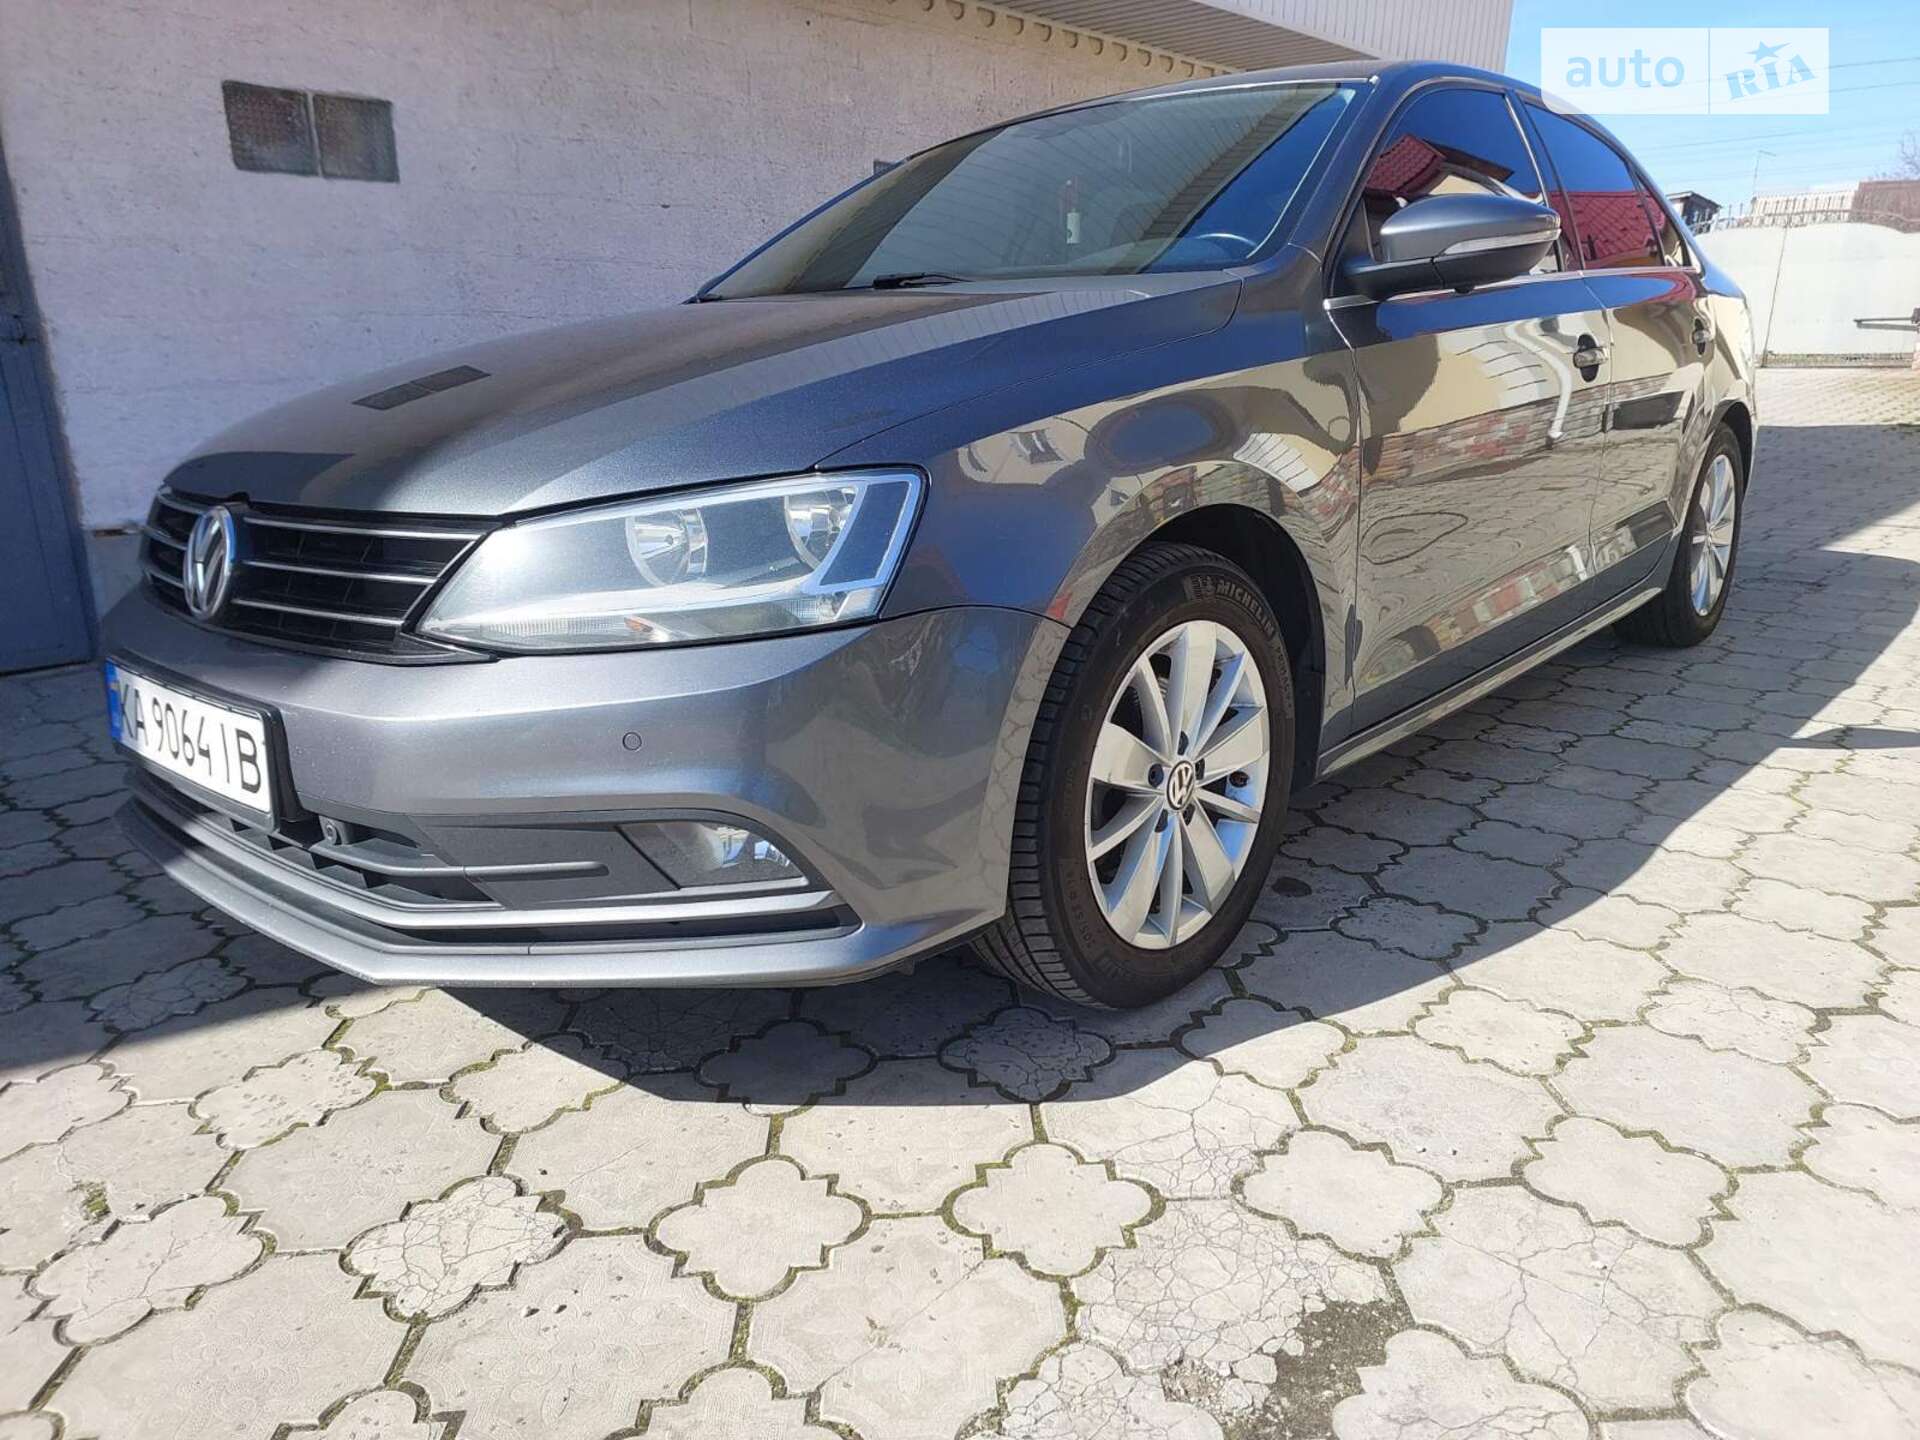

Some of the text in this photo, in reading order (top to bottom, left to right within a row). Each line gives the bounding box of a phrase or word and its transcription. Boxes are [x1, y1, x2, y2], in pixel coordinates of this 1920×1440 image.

[1215, 579, 1276, 637] MICHELIN
[120, 684, 262, 794] KA 9064 IB
